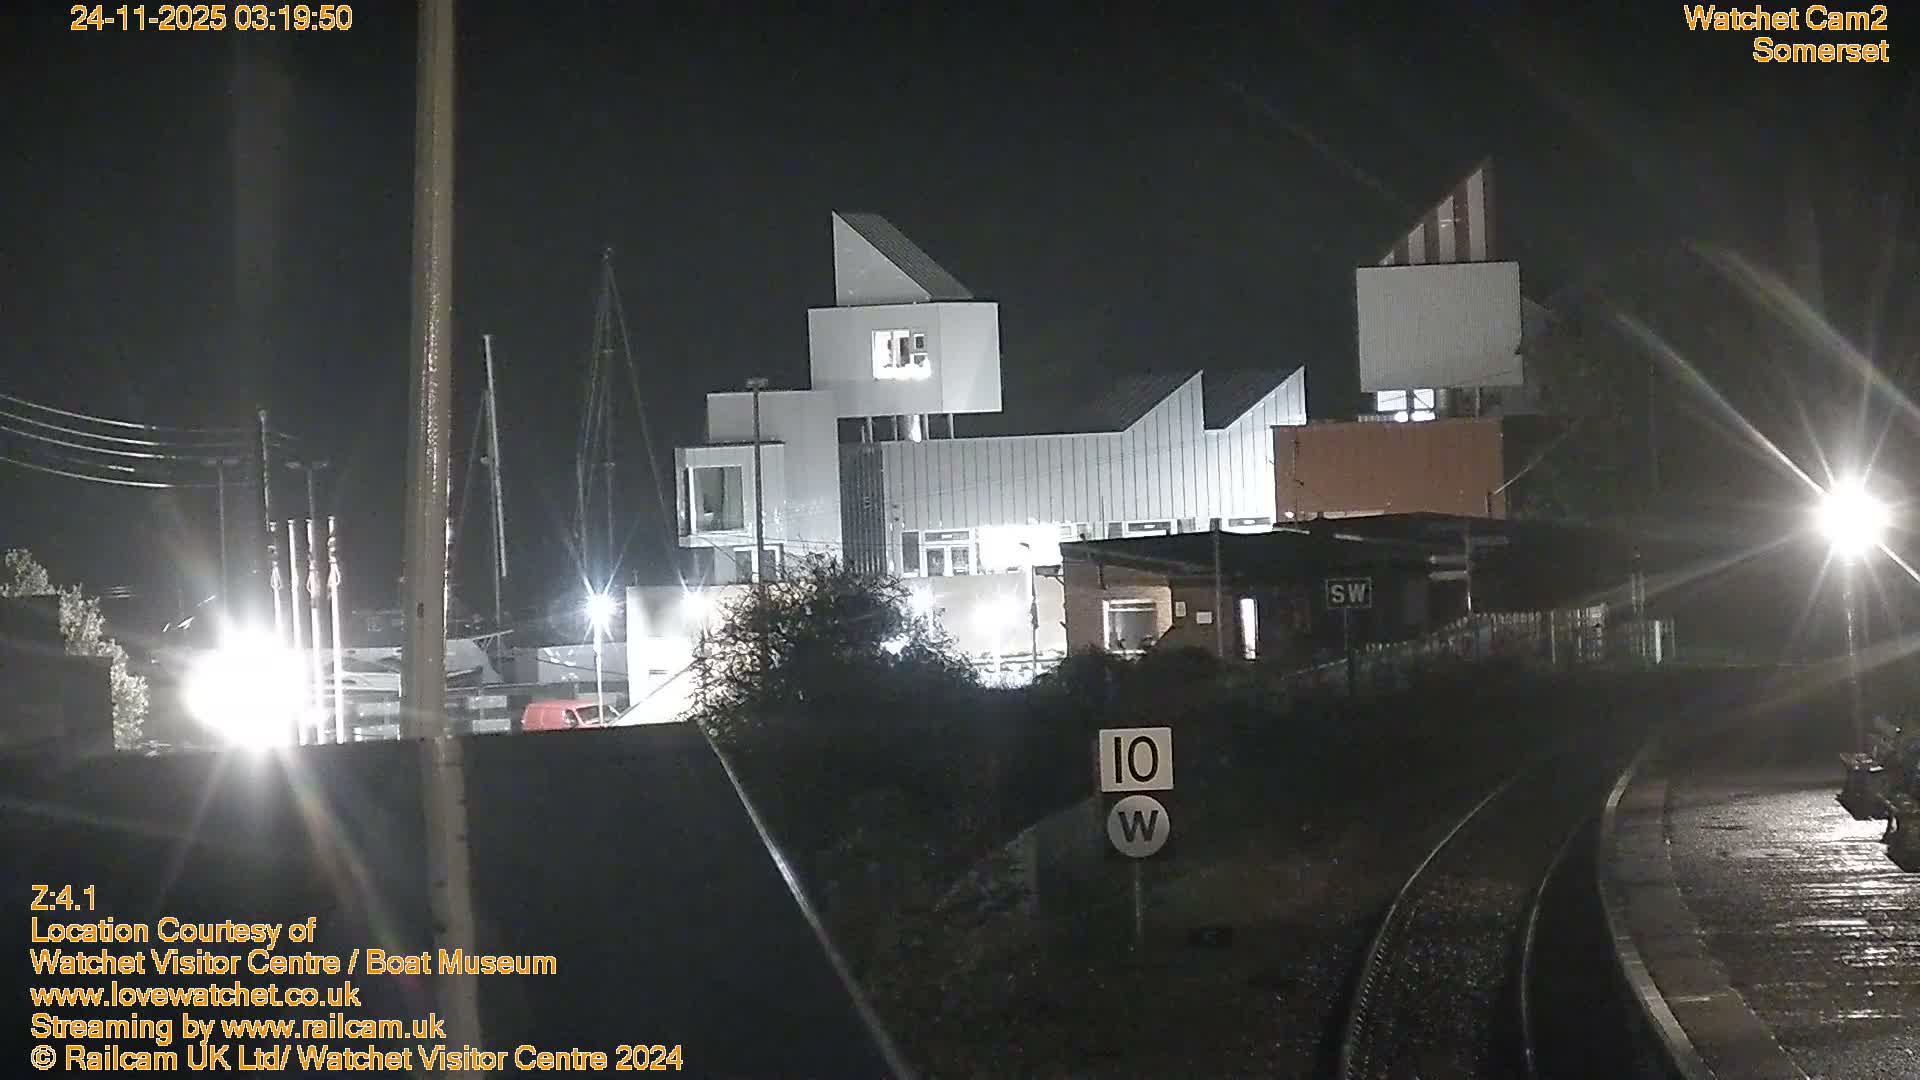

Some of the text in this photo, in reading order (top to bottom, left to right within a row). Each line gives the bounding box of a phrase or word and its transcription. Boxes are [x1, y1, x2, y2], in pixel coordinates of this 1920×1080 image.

[1331, 584, 1366, 603] SW
[1114, 736, 1158, 783] 10
[1118, 810, 1159, 842] W
